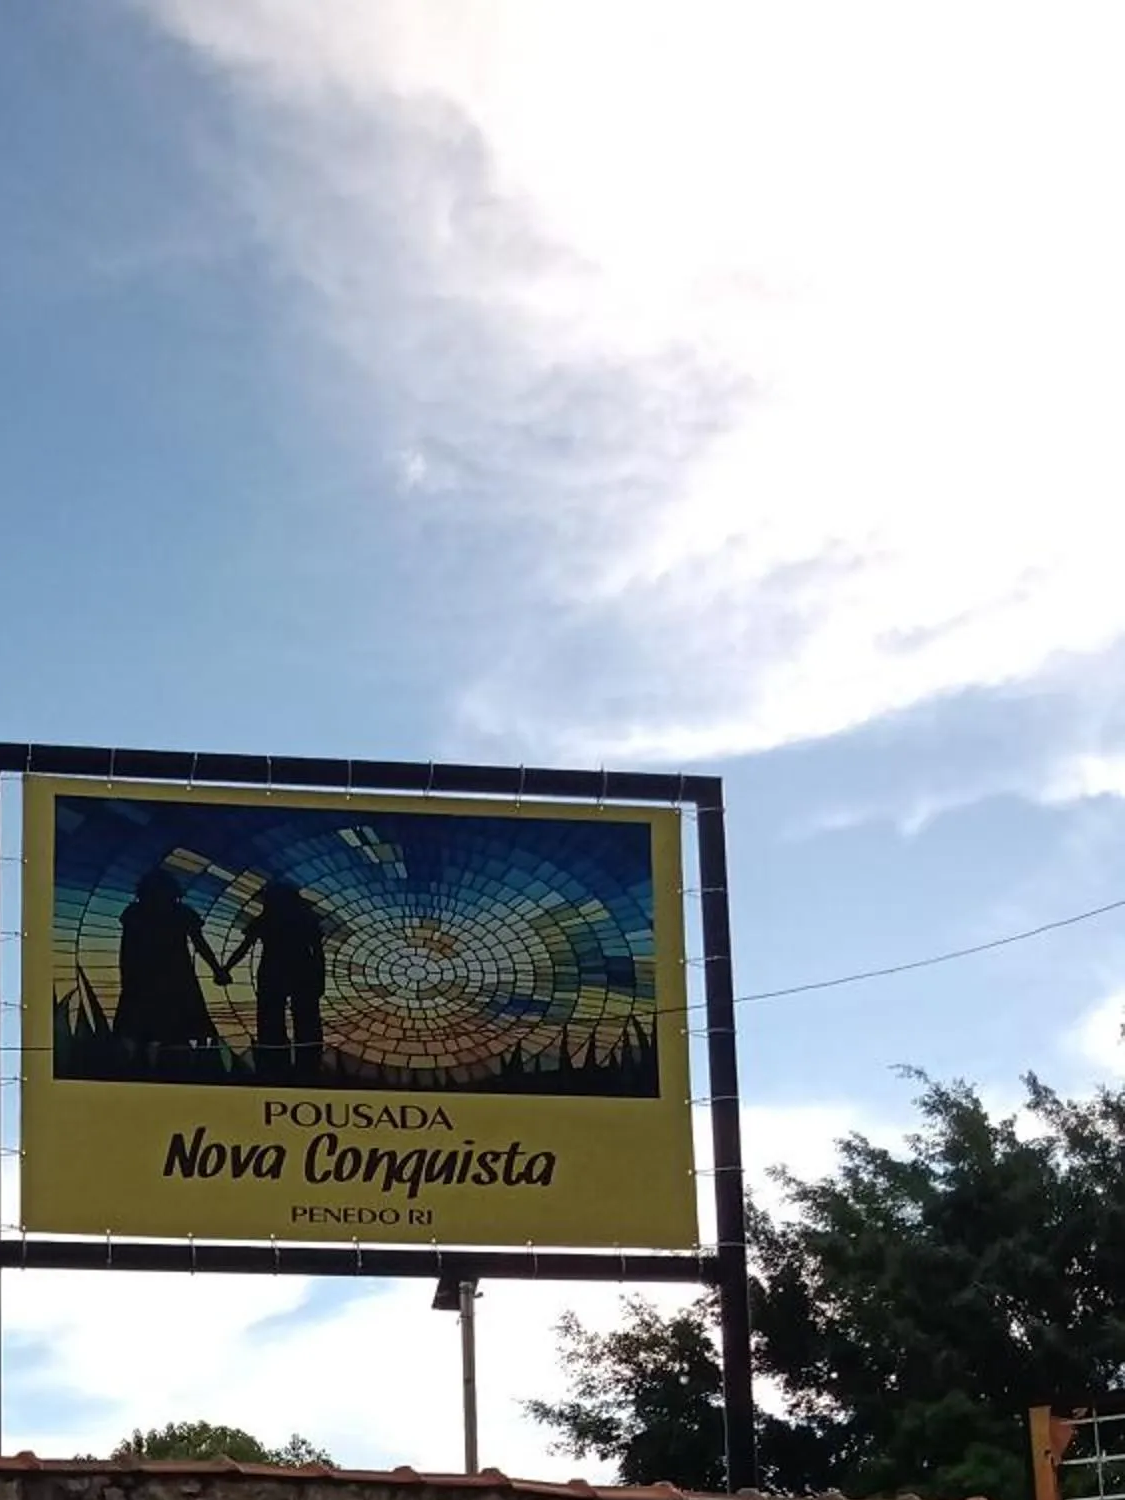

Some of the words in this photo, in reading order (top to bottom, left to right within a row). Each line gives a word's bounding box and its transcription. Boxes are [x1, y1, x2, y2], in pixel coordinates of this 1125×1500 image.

[264, 1101, 454, 1131] POUSADA
[163, 1127, 286, 1179] Nova
[304, 1133, 556, 1199] Conquista
[291, 1206, 401, 1226] PENEDO
